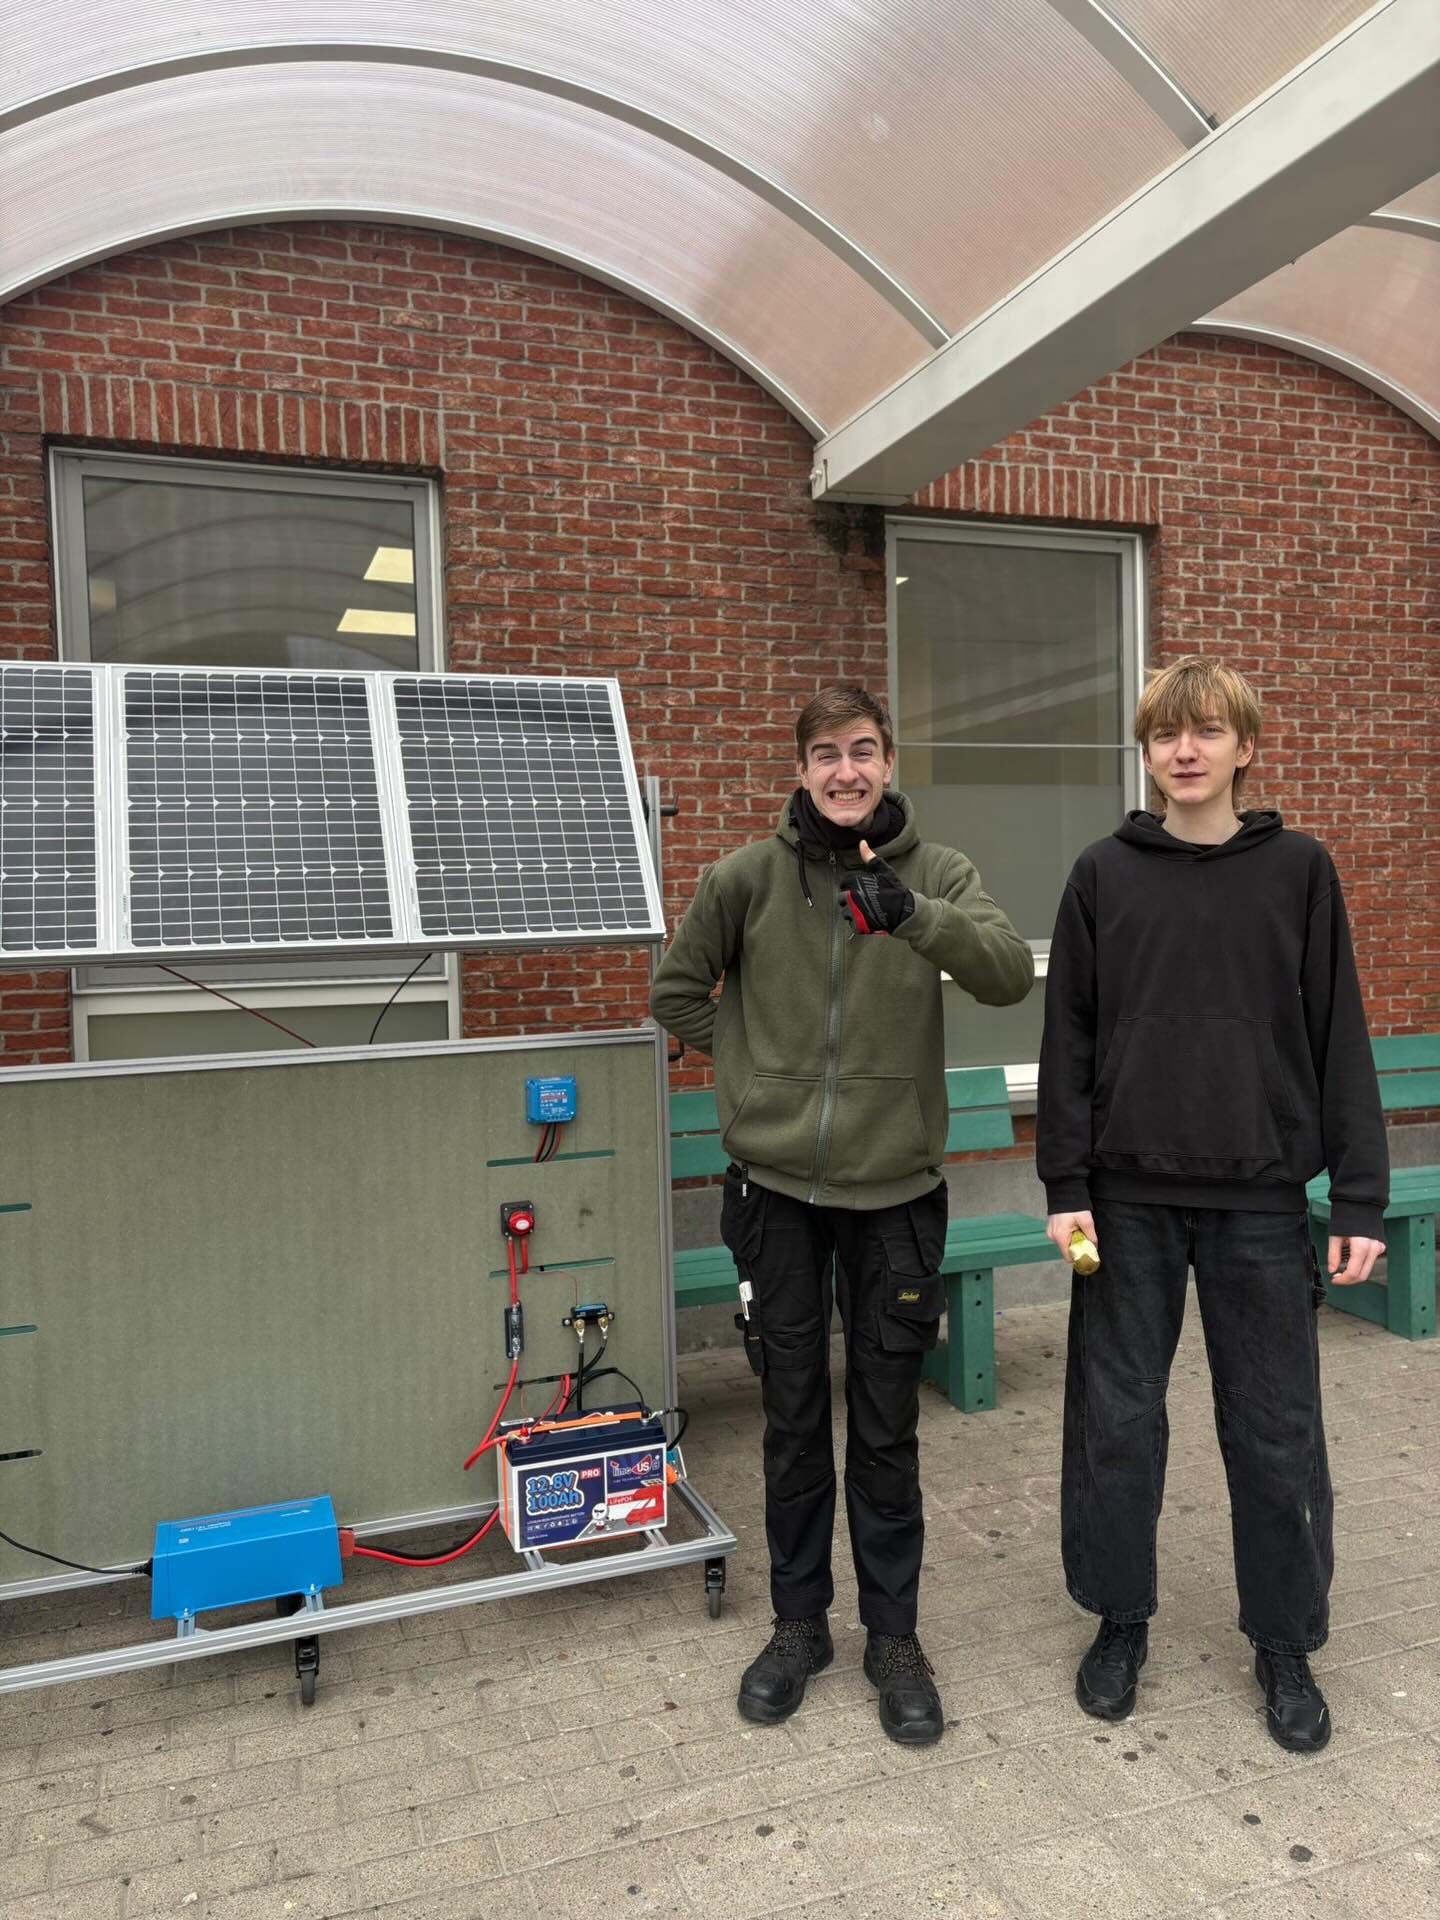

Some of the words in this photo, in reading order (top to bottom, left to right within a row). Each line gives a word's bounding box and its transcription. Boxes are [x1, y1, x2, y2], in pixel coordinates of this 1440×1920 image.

[527, 1471, 578, 1493] 12.8V
[582, 1468, 600, 1478] PRO
[528, 1489, 581, 1512] 100Ah
